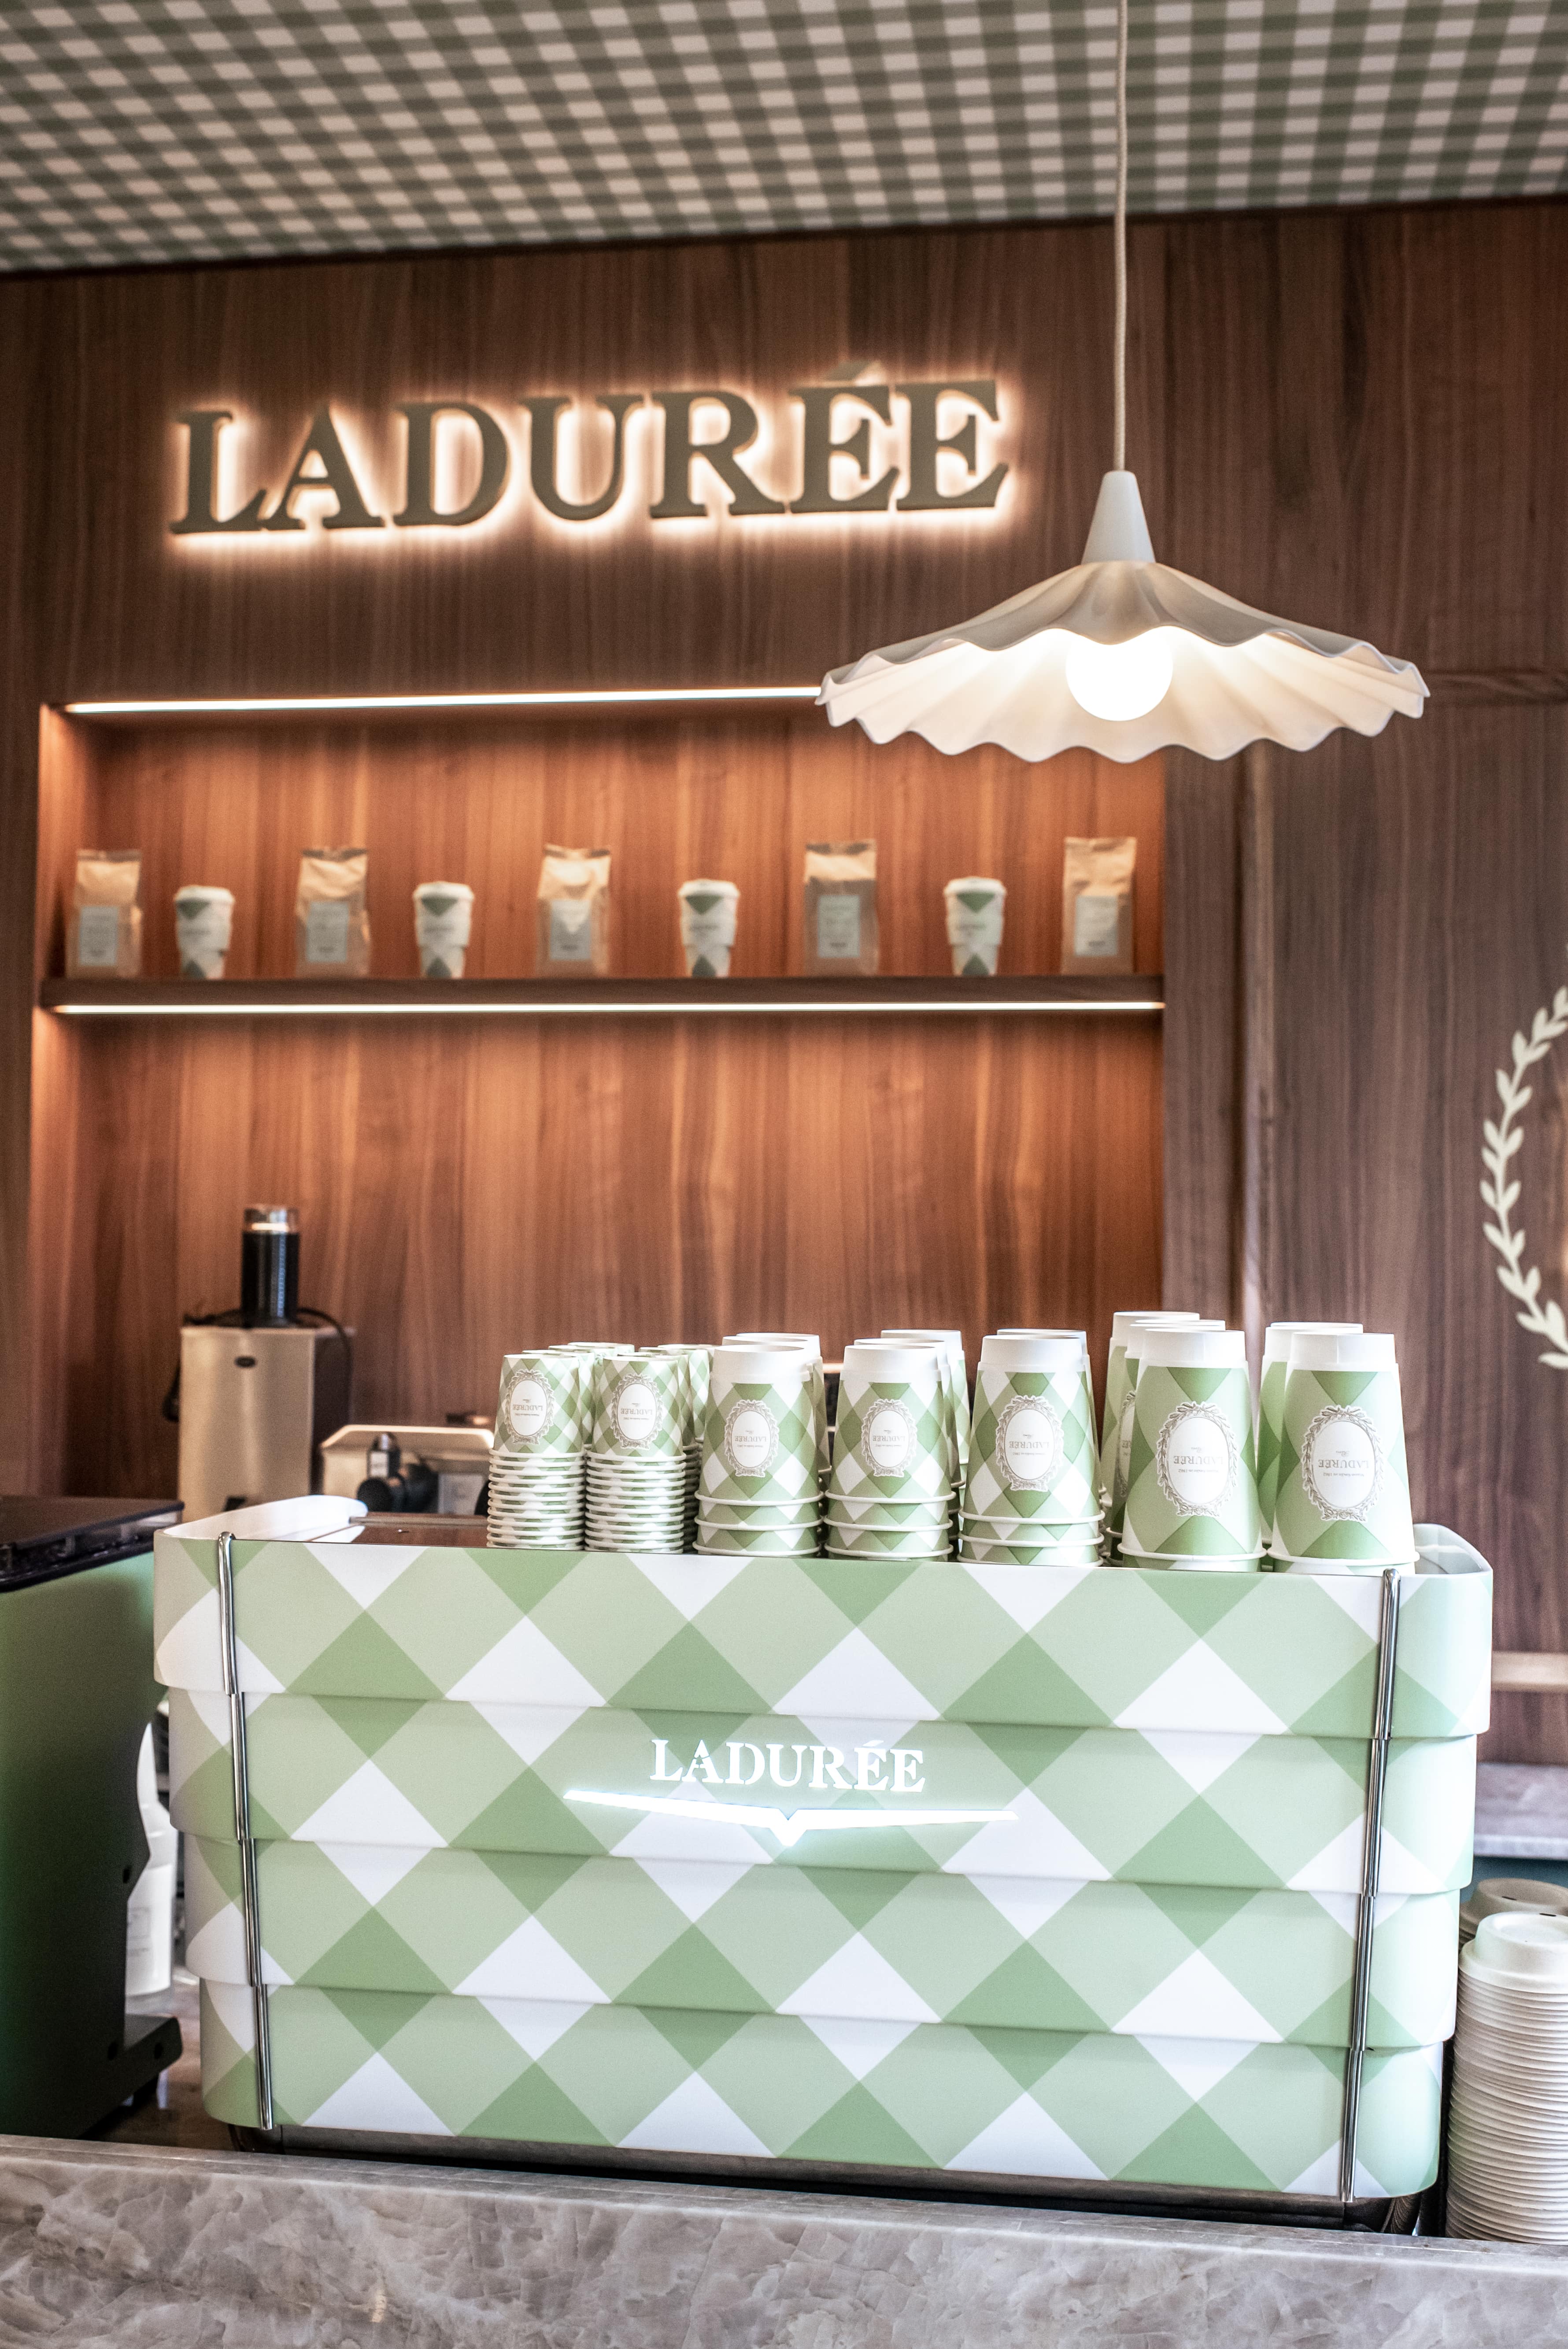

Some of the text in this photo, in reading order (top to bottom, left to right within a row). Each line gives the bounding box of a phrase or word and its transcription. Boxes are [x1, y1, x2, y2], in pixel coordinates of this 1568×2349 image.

[170, 359, 1009, 534] LADURÉE
[1173, 1456, 1223, 1465] LADURÉE
[1318, 1459, 1369, 1469] LADURÉE
[649, 1739, 926, 1793] LADURÉE
